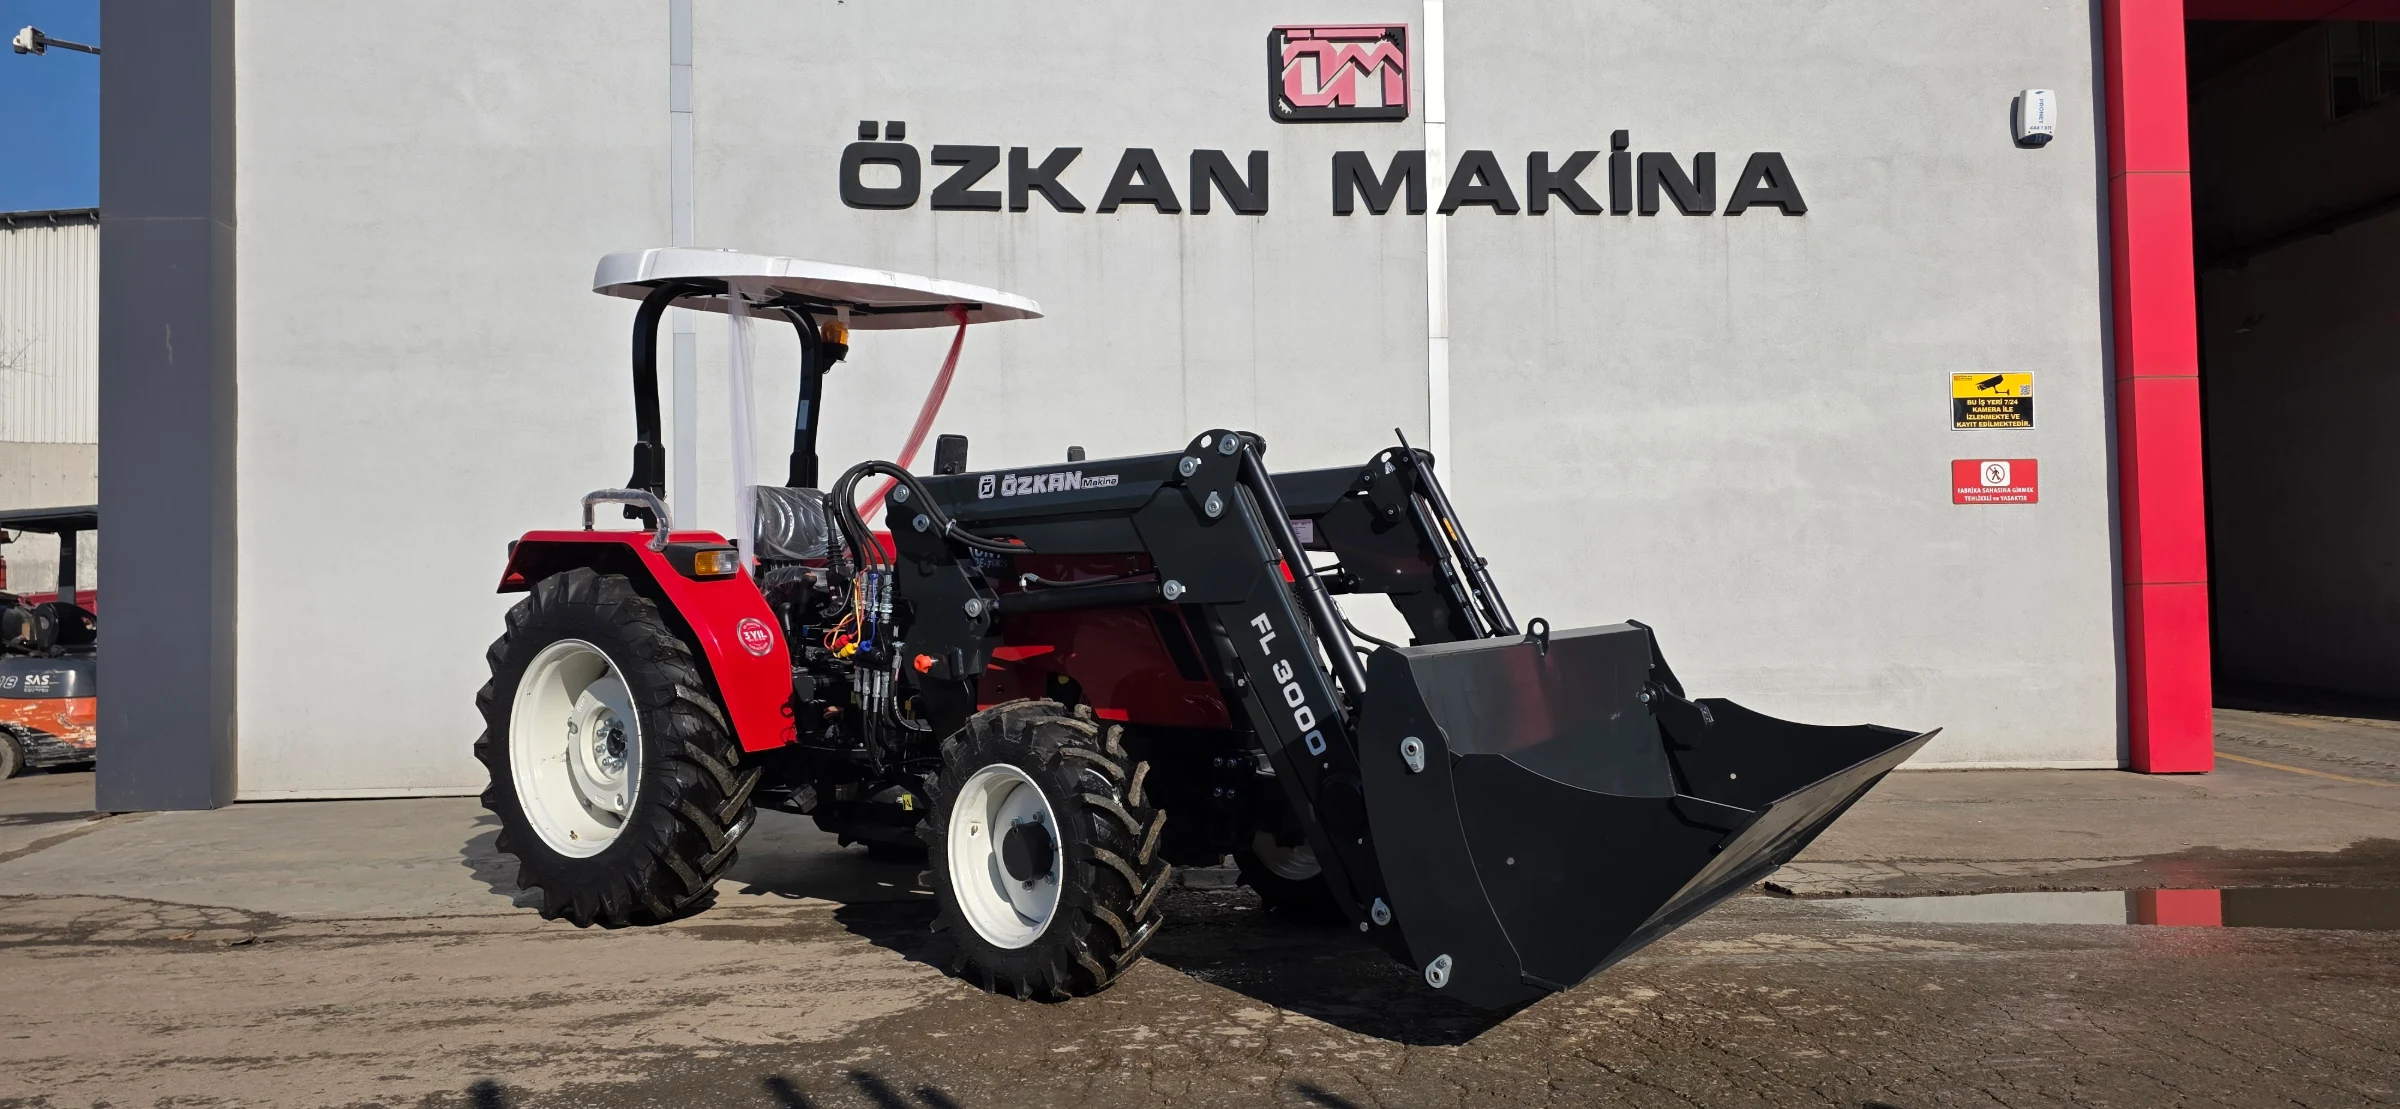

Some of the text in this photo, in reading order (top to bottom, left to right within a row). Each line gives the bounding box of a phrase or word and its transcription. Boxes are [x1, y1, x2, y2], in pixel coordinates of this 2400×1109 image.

[840, 121, 1808, 216] ÖZKAN MAKİNA
[1978, 398, 1986, 406] İŞ
[1001, 471, 1082, 496] ÖZKAN
[1083, 477, 1117, 488] Makina
[743, 631, 750, 640] 3
[750, 630, 767, 639] YIL
[24, 674, 50, 685] SAS
[1250, 612, 1327, 756] FL 3000
